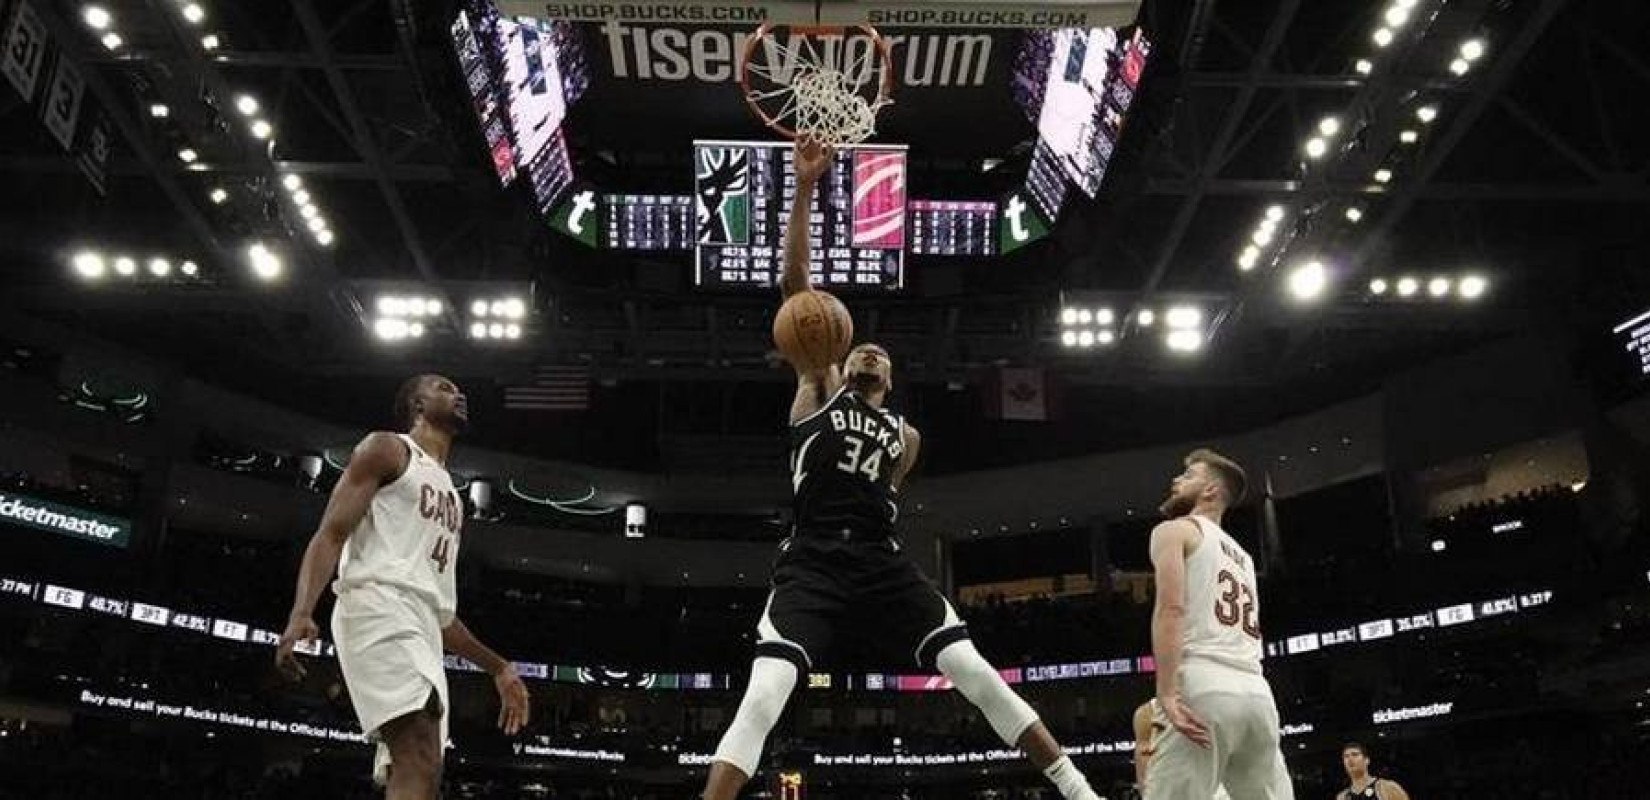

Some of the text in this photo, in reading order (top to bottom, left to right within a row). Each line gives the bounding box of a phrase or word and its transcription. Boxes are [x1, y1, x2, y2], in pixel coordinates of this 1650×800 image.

[546, 3, 768, 21] SHOP.BUCKS.COM
[868, 9, 1087, 26] SHOP.BUCKS.COM
[567, 190, 597, 236] t
[1003, 195, 1029, 242] t
[830, 410, 904, 459] BUCKS
[837, 435, 884, 482] 34
[431, 535, 449, 574] 4
[1215, 569, 1261, 640] 32
[81, 690, 105, 706] Buy
[107, 697, 132, 709] and
[134, 700, 154, 711] sell
[156, 704, 182, 718] your
[184, 706, 218, 721] Bucks
[219, 712, 255, 727] tickets
[256, 719, 269, 729] at
[270, 720, 287, 732] the
[290, 722, 327, 738] Official
[1373, 702, 1453, 724] ticketmaster
[814, 753, 832, 765] Buy
[834, 754, 853, 764] and
[855, 754, 872, 764] sell
[873, 756, 894, 766] your
[895, 753, 923, 764] Bucks
[924, 753, 955, 764] tickets
[968, 751, 984, 761] the
[986, 748, 1021, 760] Official
[1097, 743, 1113, 752] the
